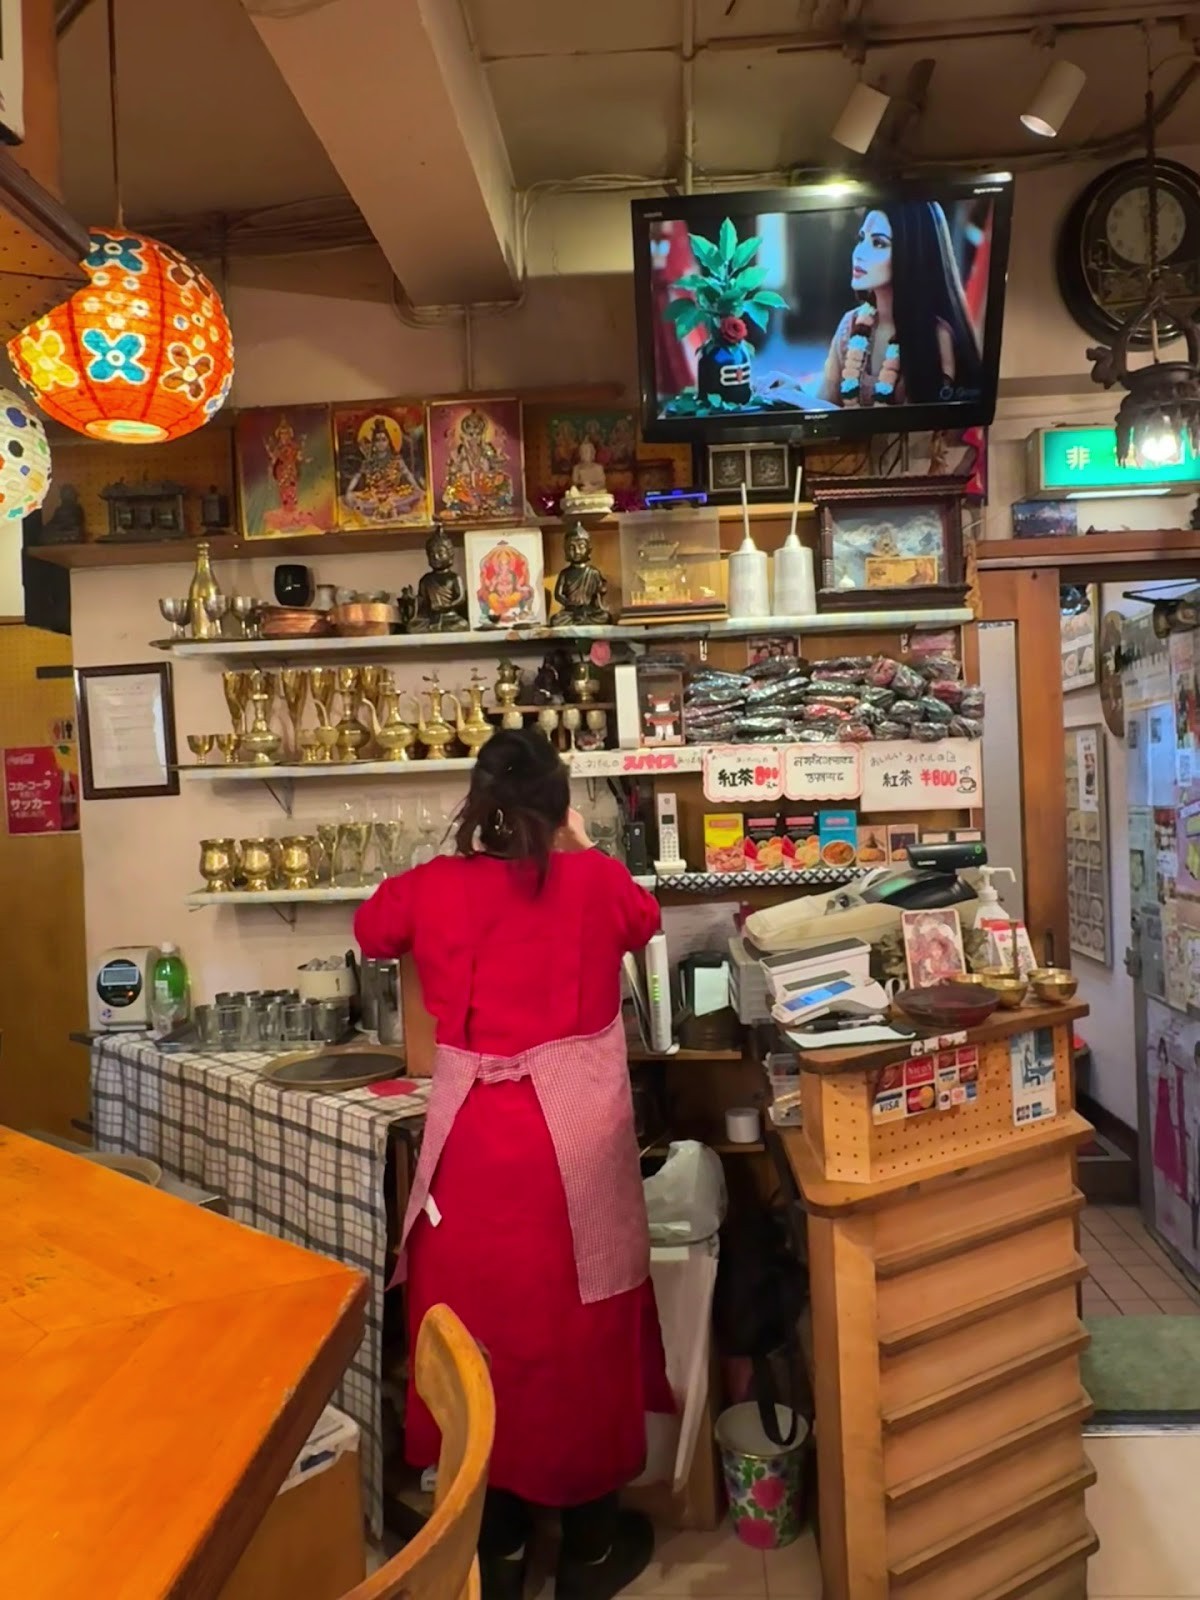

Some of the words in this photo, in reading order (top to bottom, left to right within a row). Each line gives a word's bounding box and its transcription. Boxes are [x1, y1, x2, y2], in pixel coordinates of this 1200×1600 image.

[718, 768, 753, 787] 紅茶
[882, 769, 912, 787] 紅茶
[920, 769, 957, 786] ¥800
[879, 1100, 900, 1112] VISA
